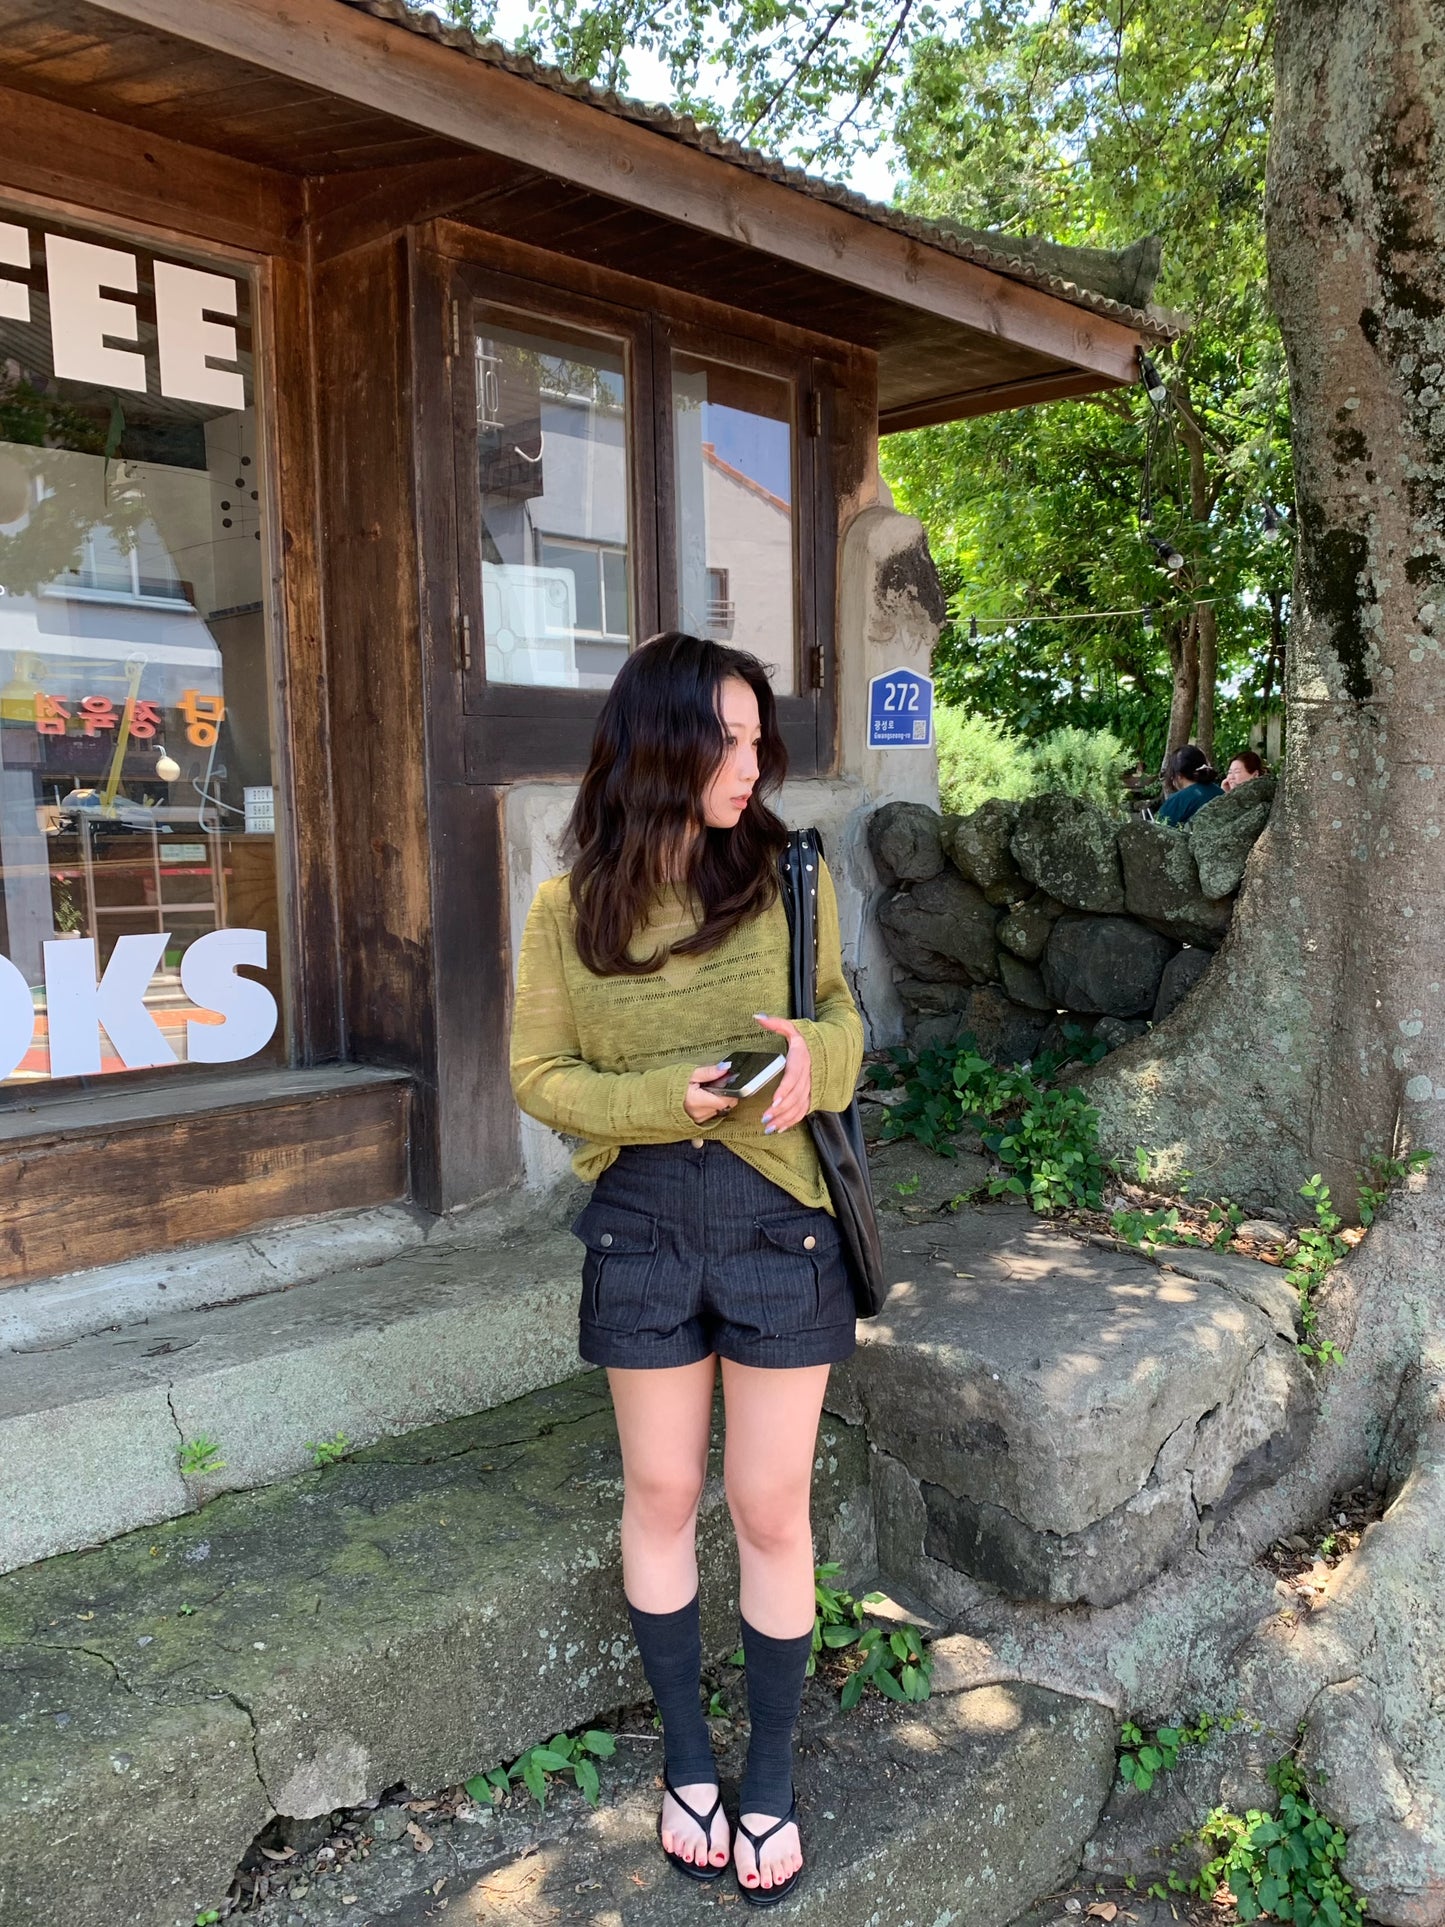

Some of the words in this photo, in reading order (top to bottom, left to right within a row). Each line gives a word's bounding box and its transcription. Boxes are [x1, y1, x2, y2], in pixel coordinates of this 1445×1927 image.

[883, 682, 920, 711] 272
[874, 720, 895, 731] 광성로
[873, 732, 911, 740] Gwangseong-ro
